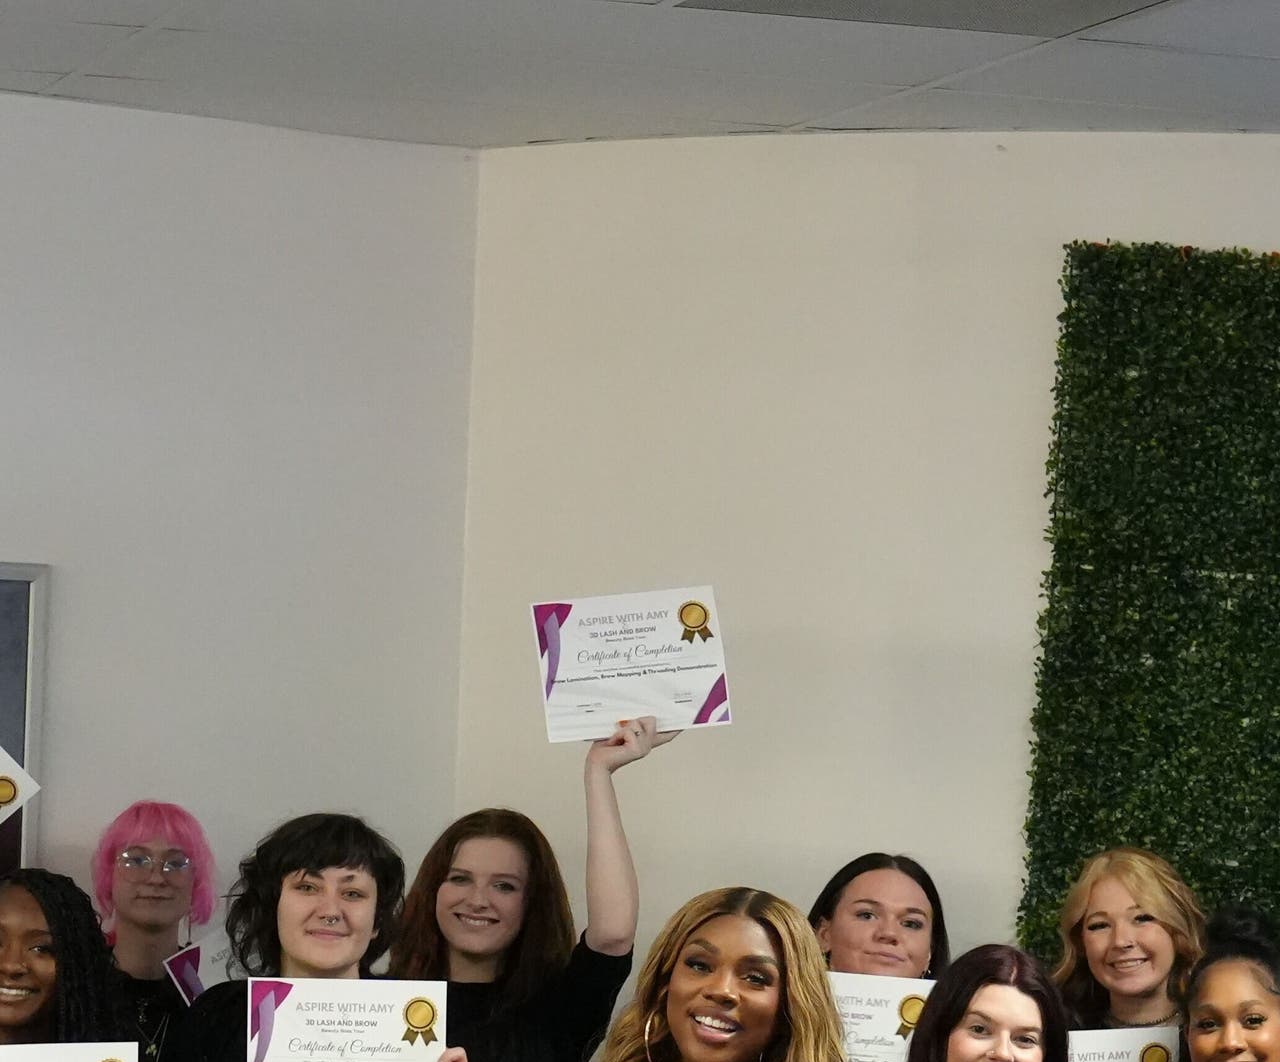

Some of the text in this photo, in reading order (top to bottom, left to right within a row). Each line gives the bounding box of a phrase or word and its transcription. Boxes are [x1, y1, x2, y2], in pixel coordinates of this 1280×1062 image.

[578, 610, 669, 627] ASPIRE WITH AMY
[599, 630, 618, 638] LASH
[618, 628, 634, 636] AND
[635, 626, 657, 634] BROW
[577, 644, 683, 666] Certificate of Completion
[295, 1002, 395, 1013] ASPIRE WITH AMY
[316, 1019, 336, 1027] LASH
[288, 1038, 402, 1057] Certificate of Completion
